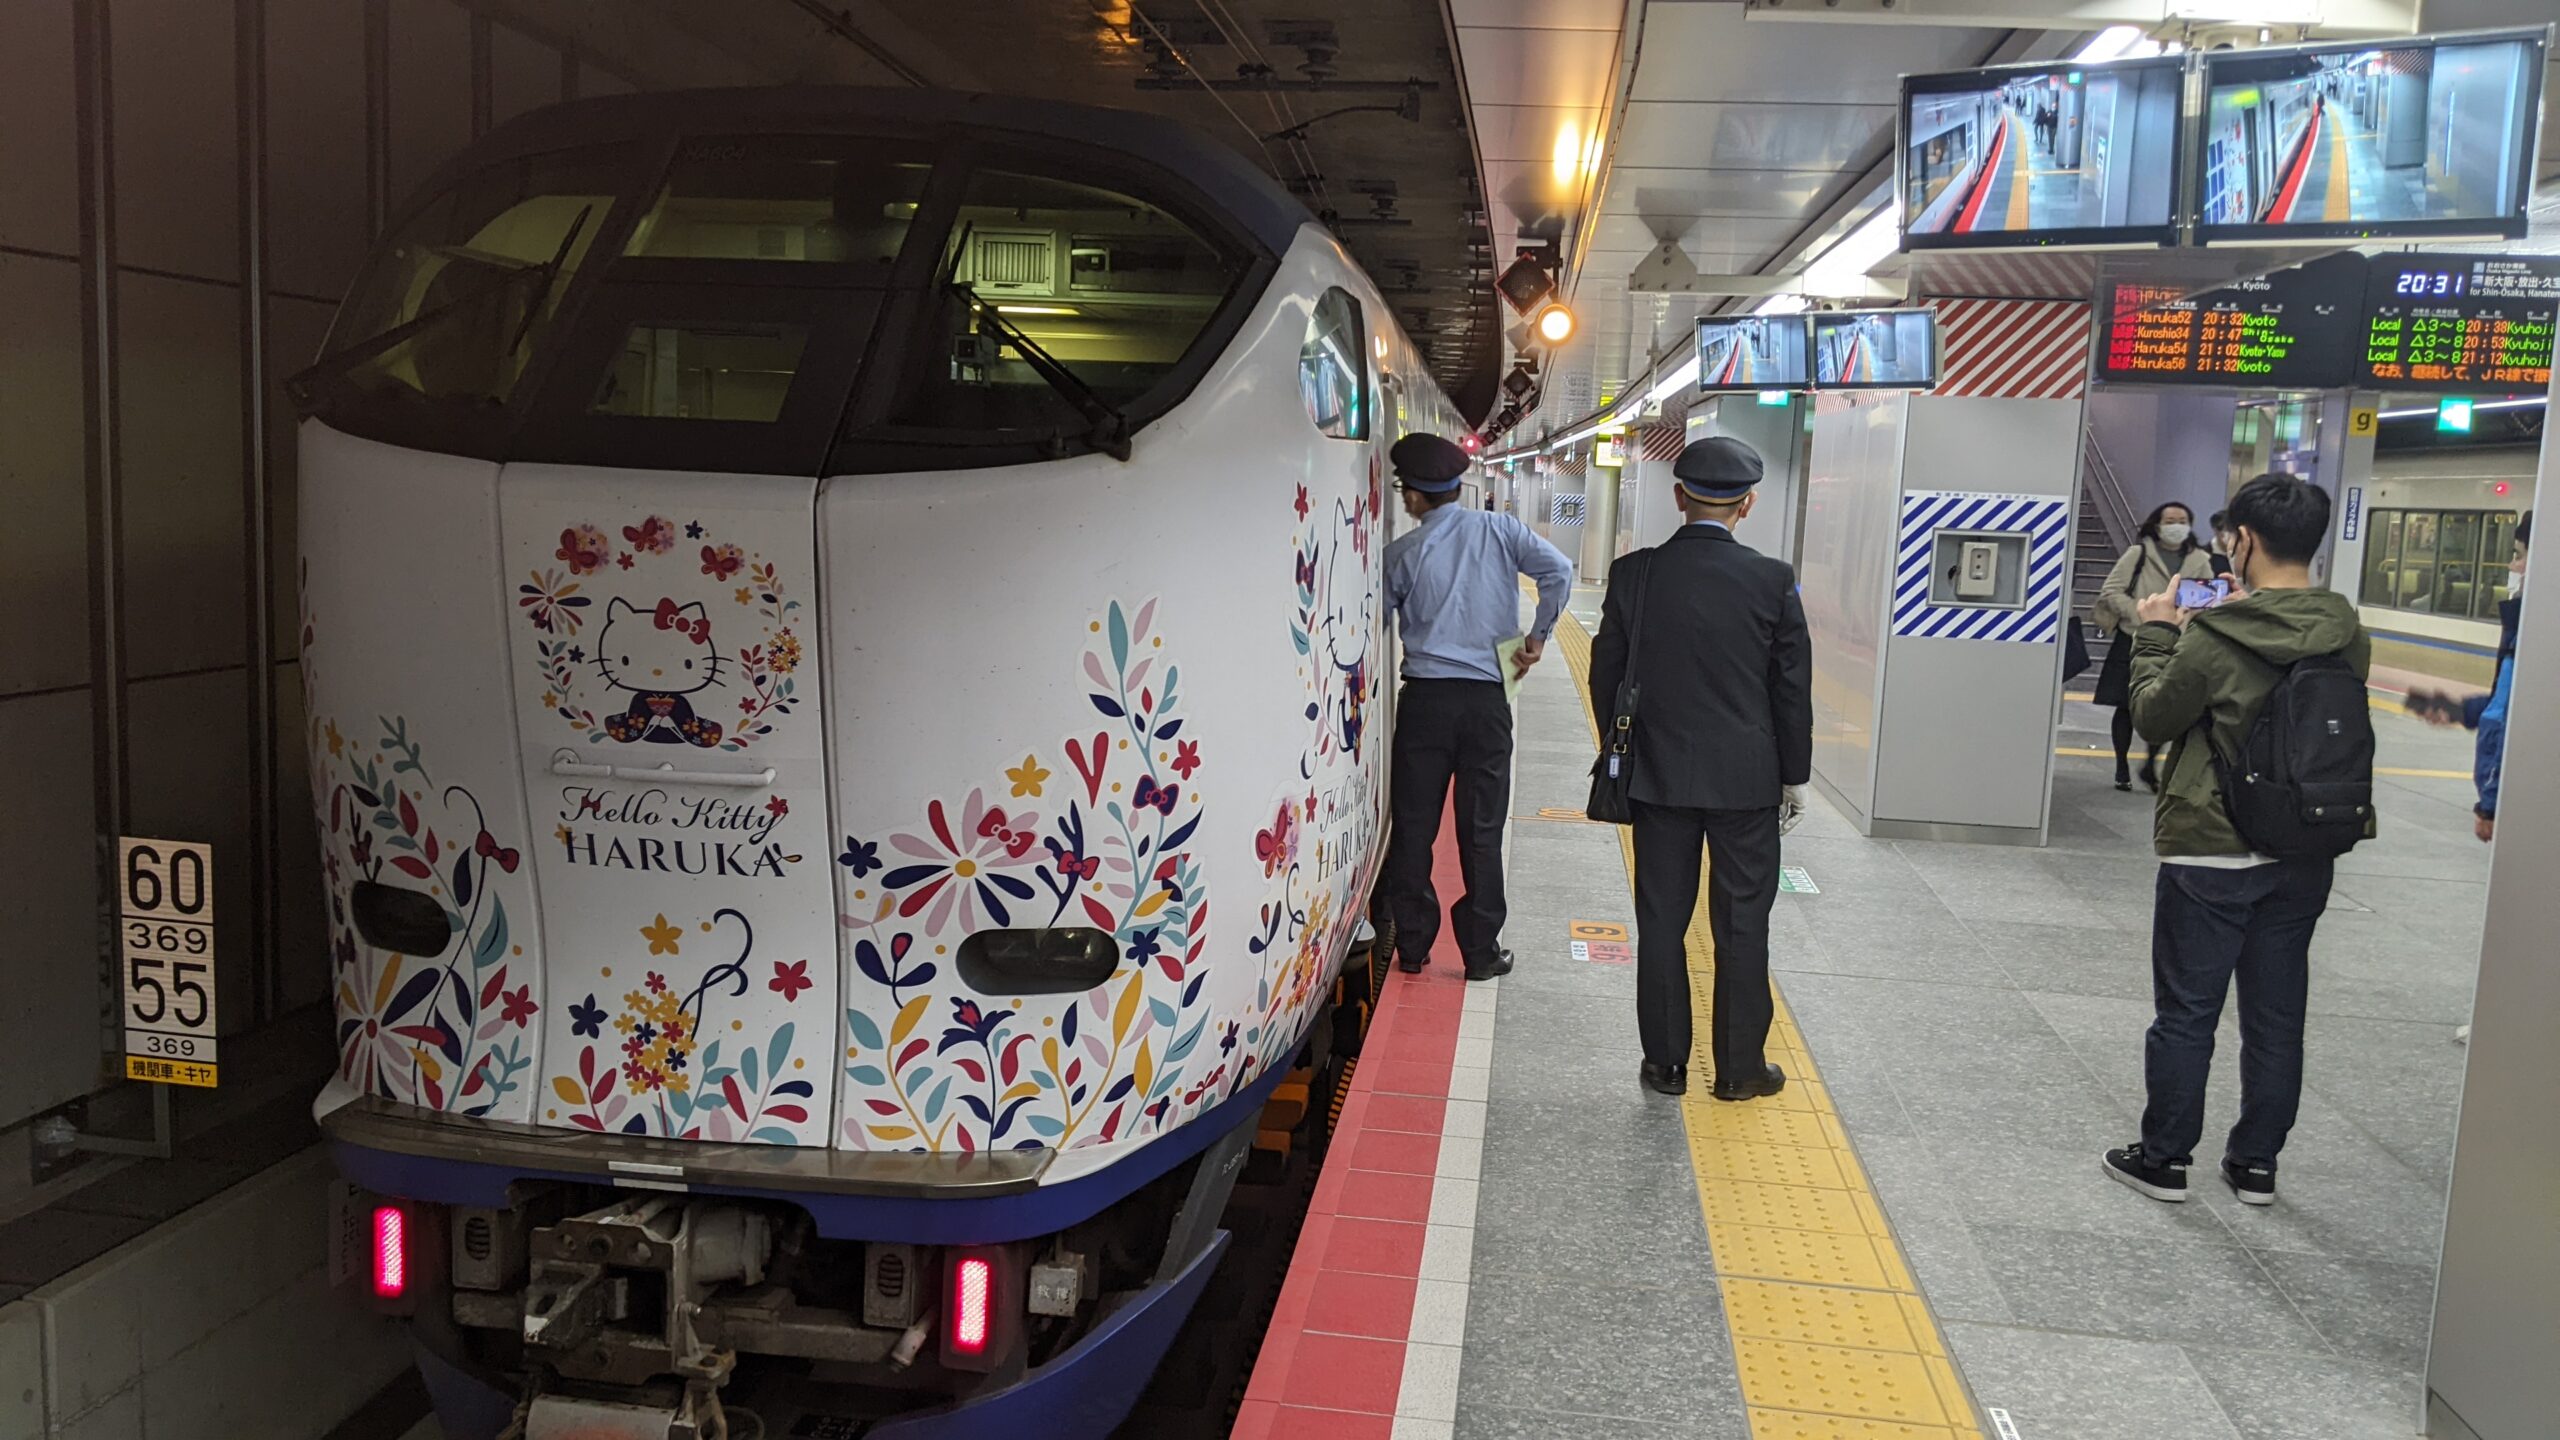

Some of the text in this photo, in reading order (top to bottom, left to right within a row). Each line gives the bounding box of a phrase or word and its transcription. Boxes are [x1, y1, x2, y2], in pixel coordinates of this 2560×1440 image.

[2397, 274, 2462, 294] 20:31
[2470, 287, 2481, 297] for
[2138, 311, 2193, 324] Haruka52
[2243, 313, 2277, 326] Kyoto
[2371, 317, 2402, 330] Local
[2507, 321, 2554, 335] Kyuhoji
[2137, 326, 2190, 339] Kuroshio34
[2370, 333, 2399, 346] Local
[2505, 337, 2552, 350] Kyuhoji
[2134, 341, 2188, 354] Haruka54
[2132, 357, 2186, 370] Haruka56
[2237, 359, 2272, 373] Kyoto
[2368, 348, 2397, 361] Local
[2502, 353, 2549, 367] Kyuhoji
[2356, 412, 2371, 431] g
[560, 786, 788, 845] Hello Kitty
[564, 830, 788, 878] HARUKA
[128, 845, 205, 915] 60
[128, 922, 208, 955] 369
[131, 957, 208, 1028] 55
[146, 1036, 196, 1057] 369
[132, 1060, 211, 1083] 機関車・キヤ
